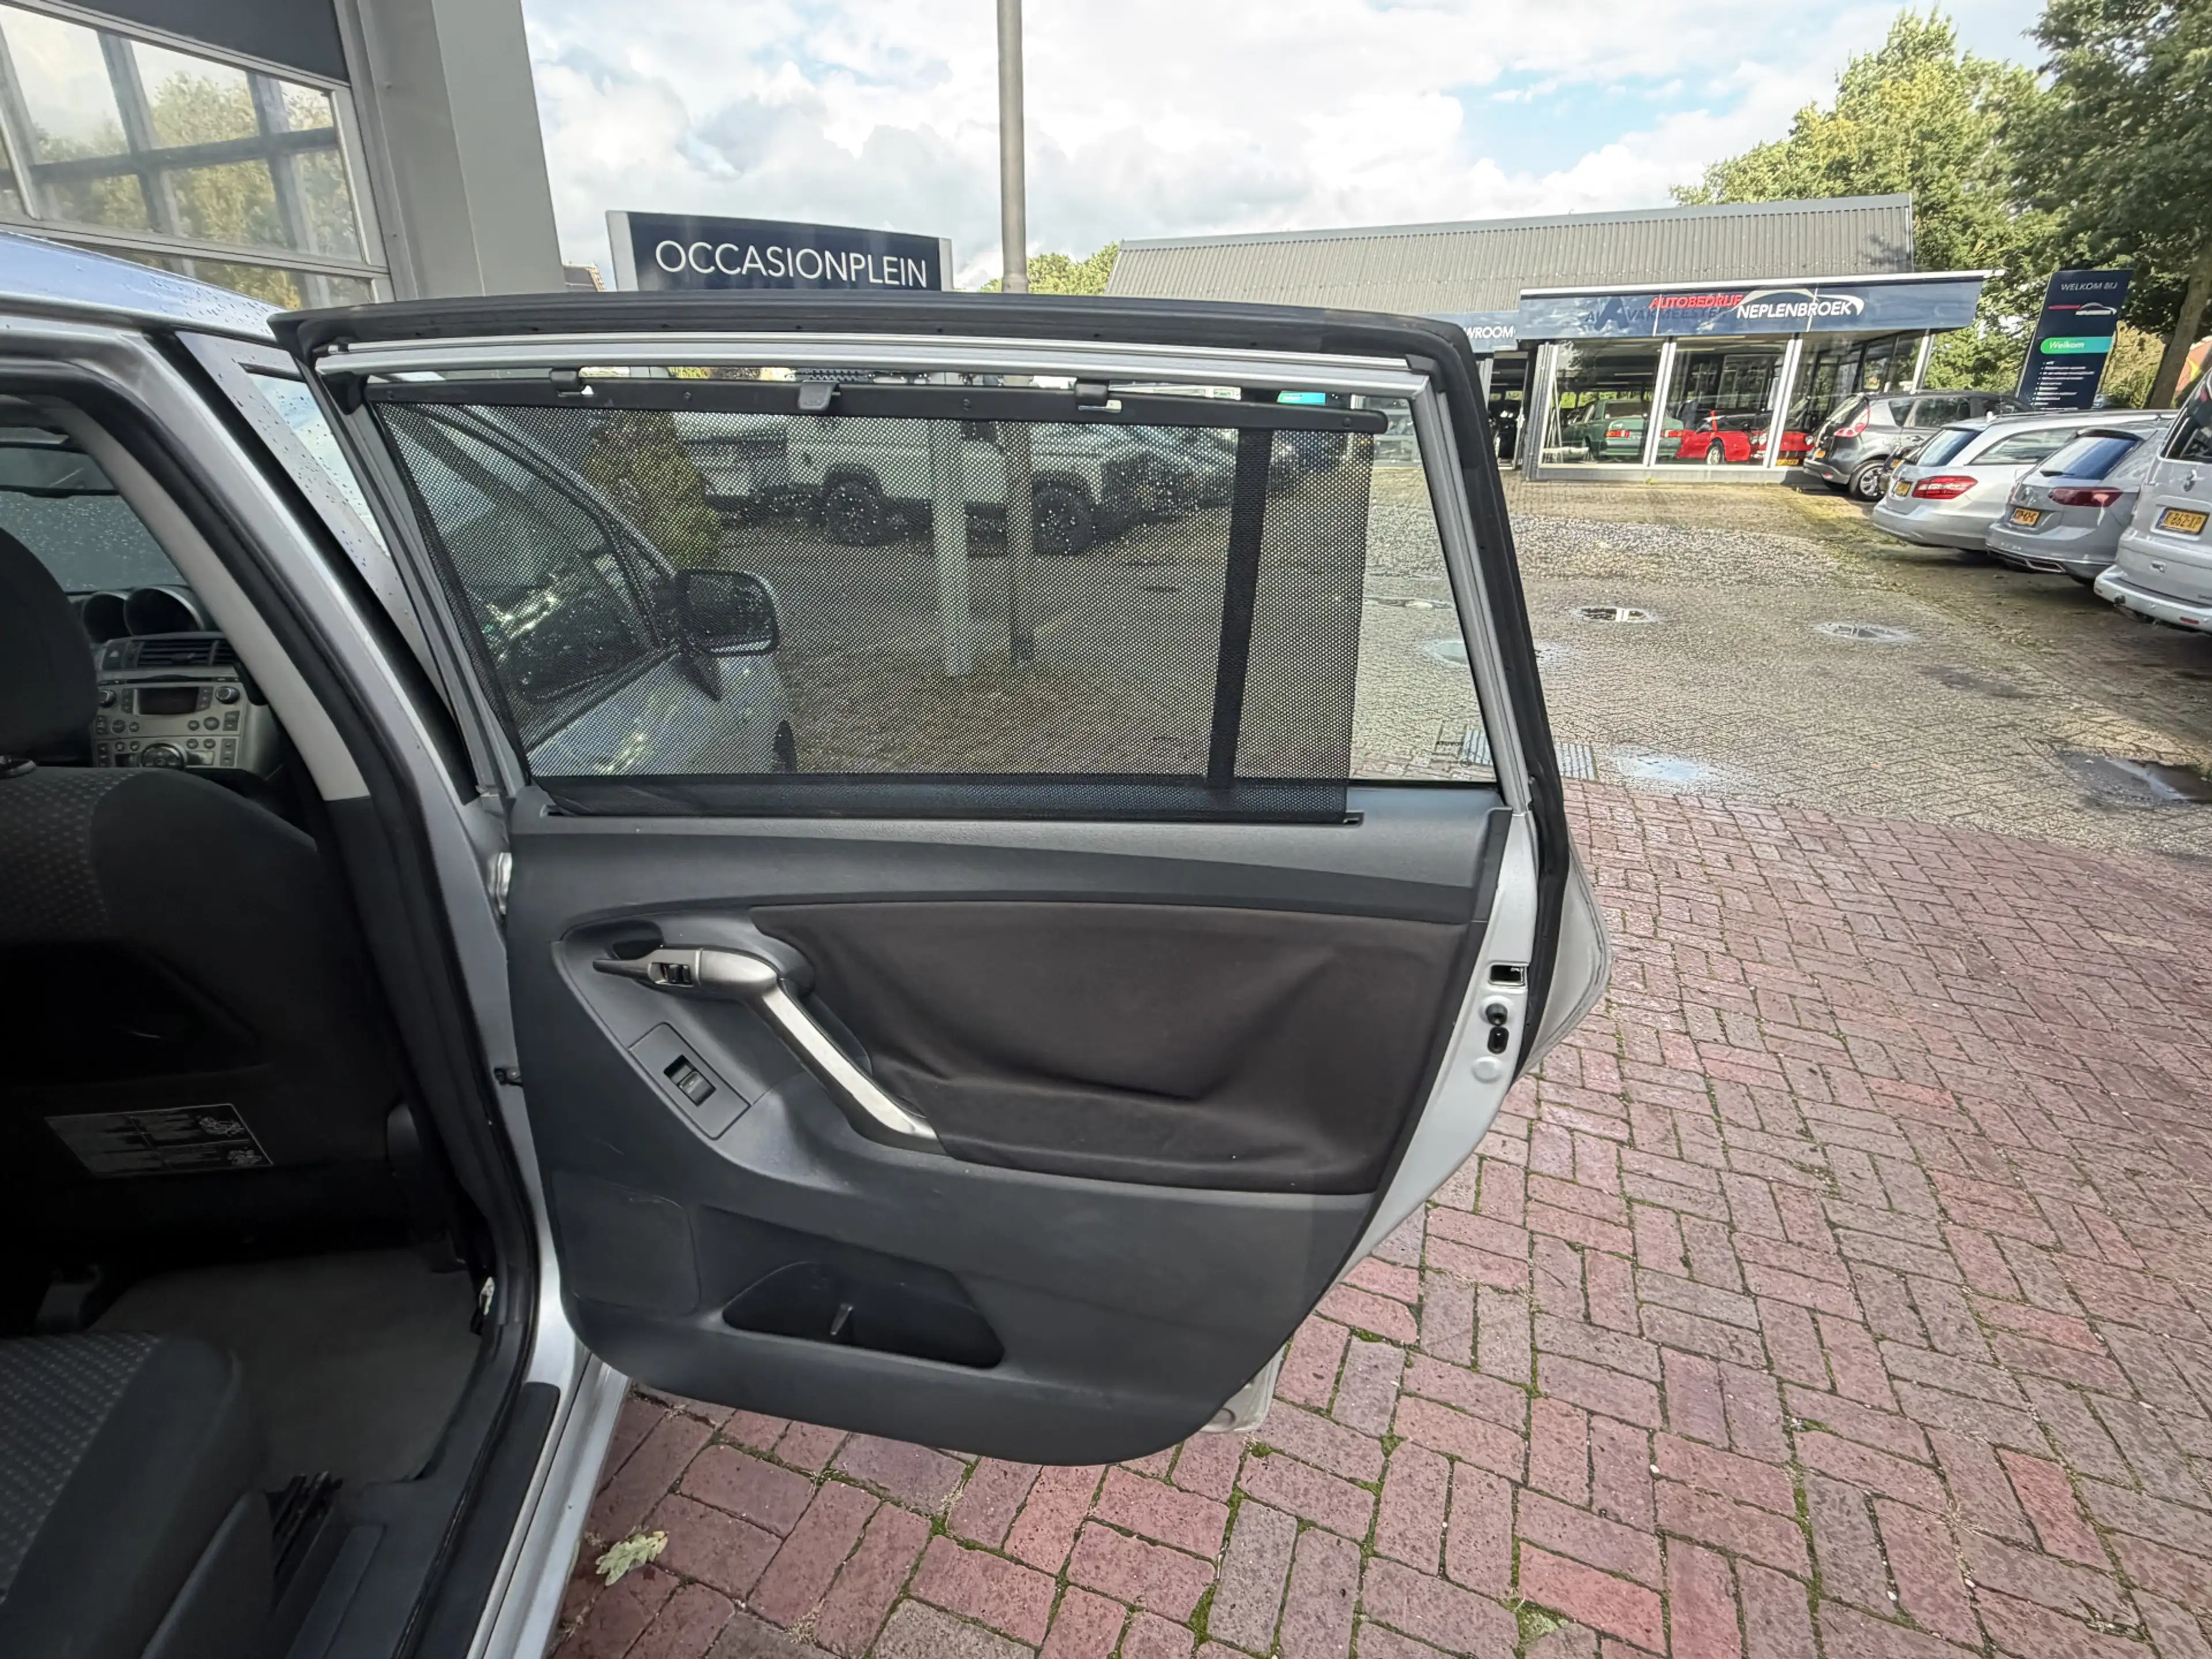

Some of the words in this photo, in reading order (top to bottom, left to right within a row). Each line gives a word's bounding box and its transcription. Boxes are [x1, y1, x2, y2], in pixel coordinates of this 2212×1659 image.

[655, 240, 927, 288] OCCASIONPLEIN
[2061, 282, 2103, 291] WELKOM
[1649, 294, 1743, 309] AUTOBEDRIJF
[1737, 301, 1851, 319] NEPLENBROEK
